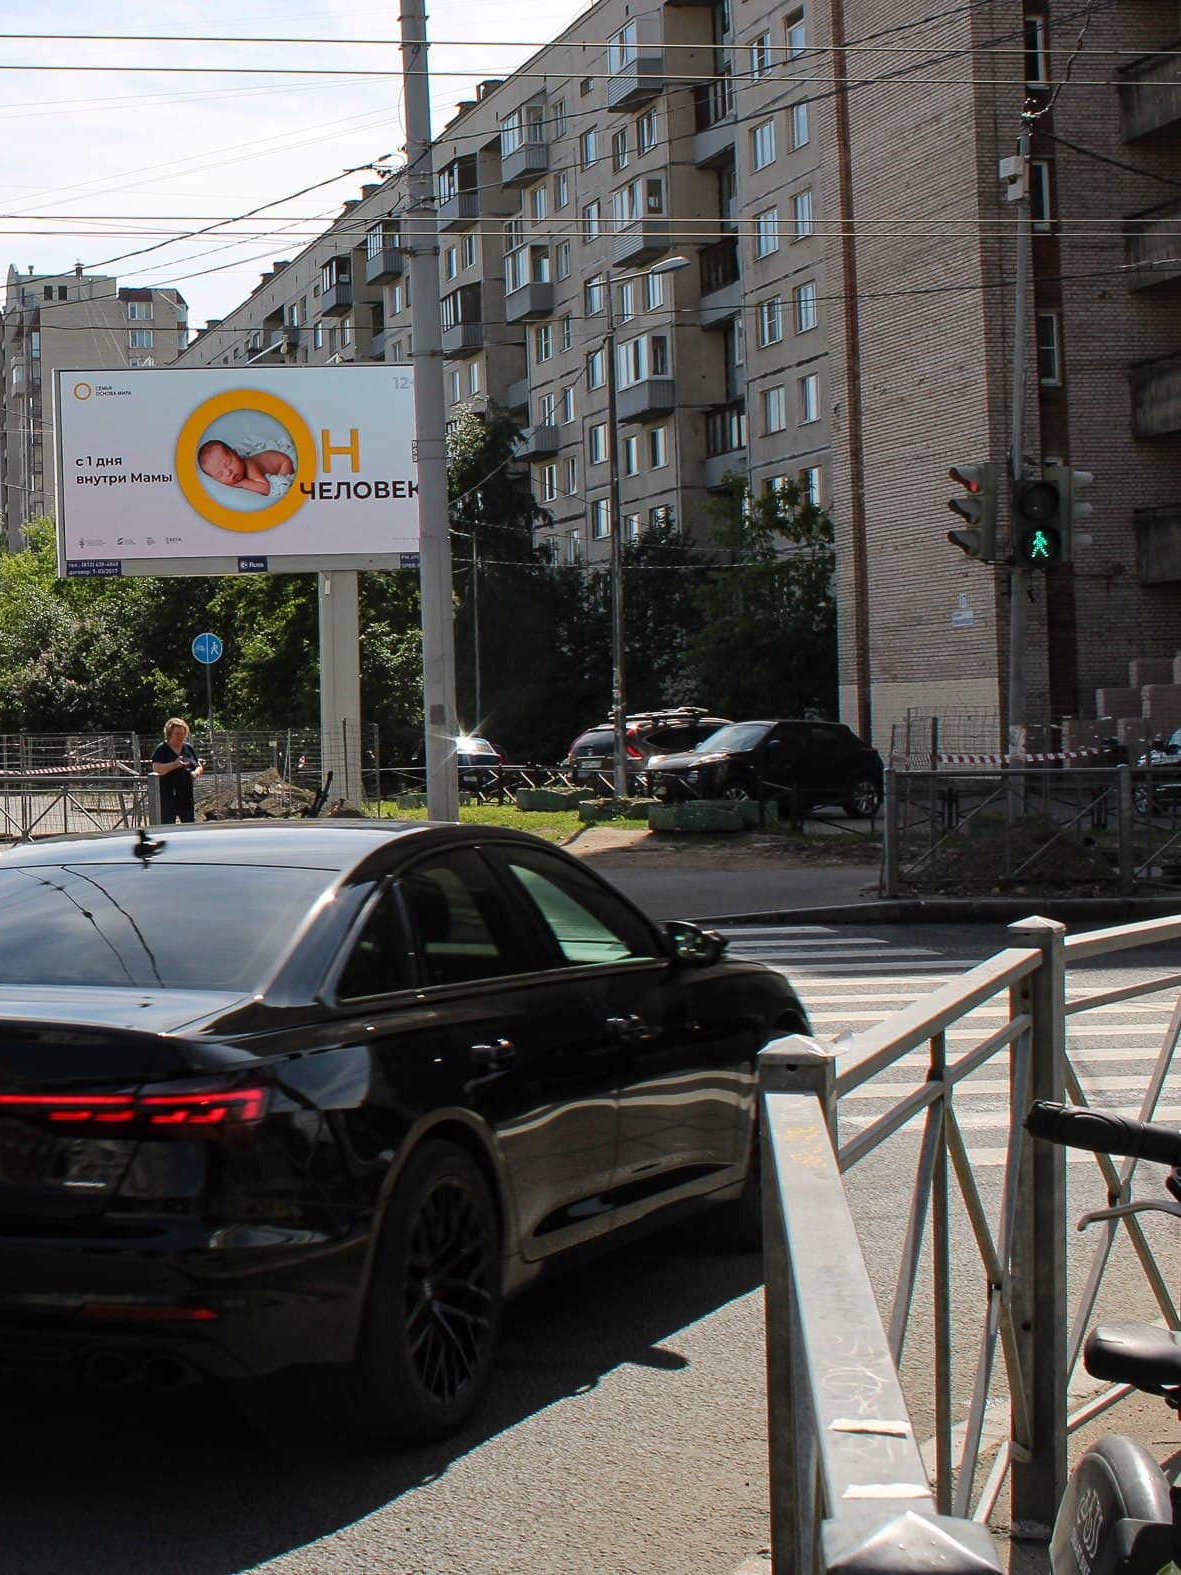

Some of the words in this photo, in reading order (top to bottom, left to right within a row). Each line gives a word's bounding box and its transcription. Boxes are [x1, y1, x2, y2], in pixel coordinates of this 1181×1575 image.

[86, 456, 92, 466] 1
[96, 457, 123, 468] дня
[76, 474, 127, 486] внутри
[130, 472, 173, 484] Мамы
[300, 480, 419, 501] ЧЕЛОВЕК
